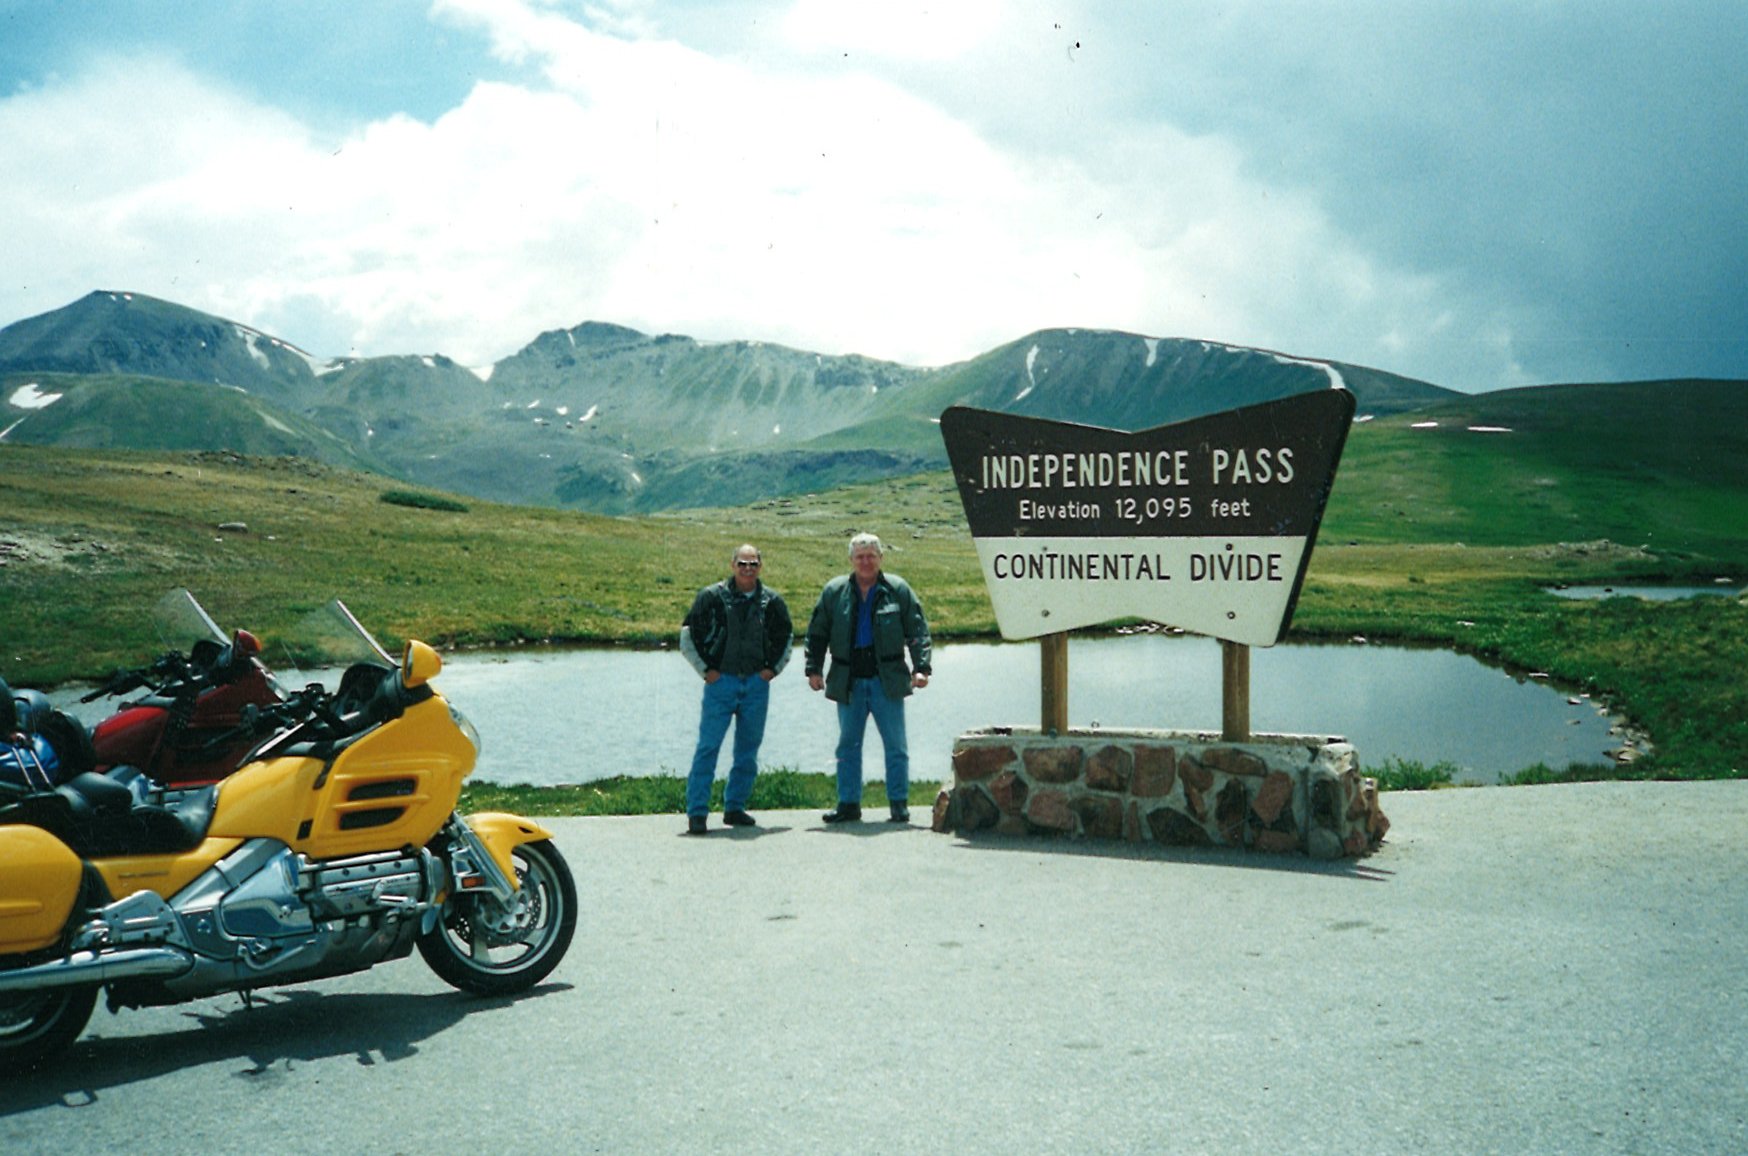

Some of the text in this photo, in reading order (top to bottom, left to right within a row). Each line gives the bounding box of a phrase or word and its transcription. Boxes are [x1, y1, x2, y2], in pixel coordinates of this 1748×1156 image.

[982, 447, 1295, 490] INDEPENDENCE PASS
[1019, 498, 1251, 525] Elevation 12,095 feet
[993, 553, 1283, 582] CONTINENTAL DIVIDE
